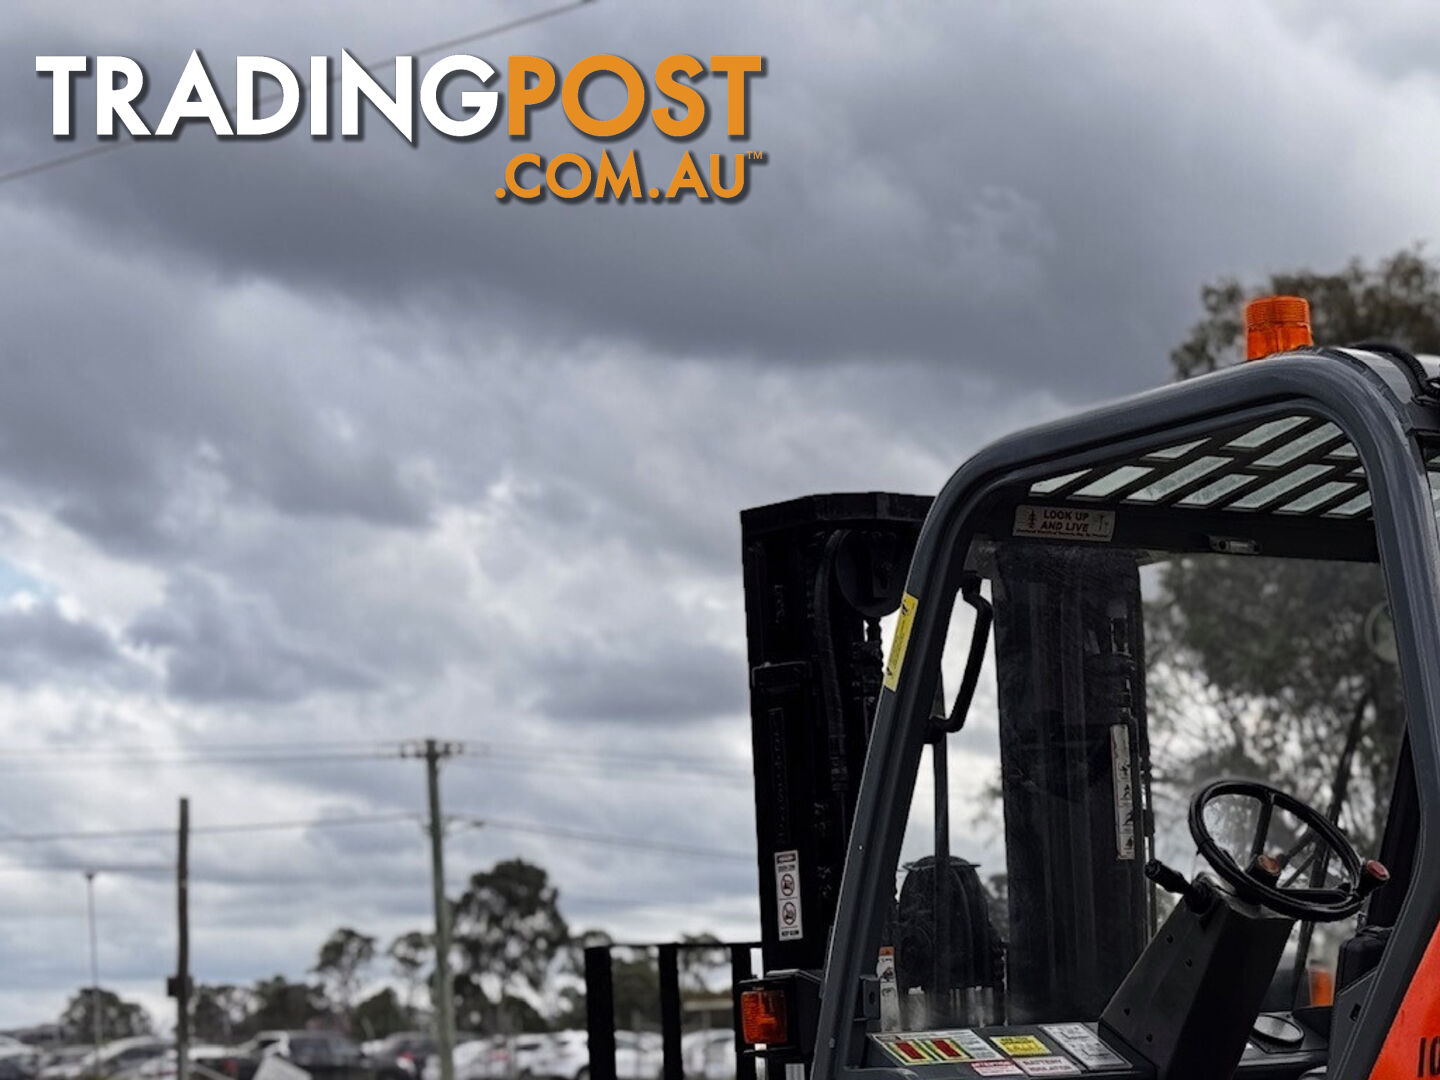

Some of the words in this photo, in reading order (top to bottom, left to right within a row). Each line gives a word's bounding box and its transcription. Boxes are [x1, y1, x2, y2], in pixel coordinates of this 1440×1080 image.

[1043, 509, 1073, 520] LOOK
[1075, 511, 1090, 522] UP
[1040, 520, 1063, 531] AND
[1065, 522, 1090, 533] LIVE
